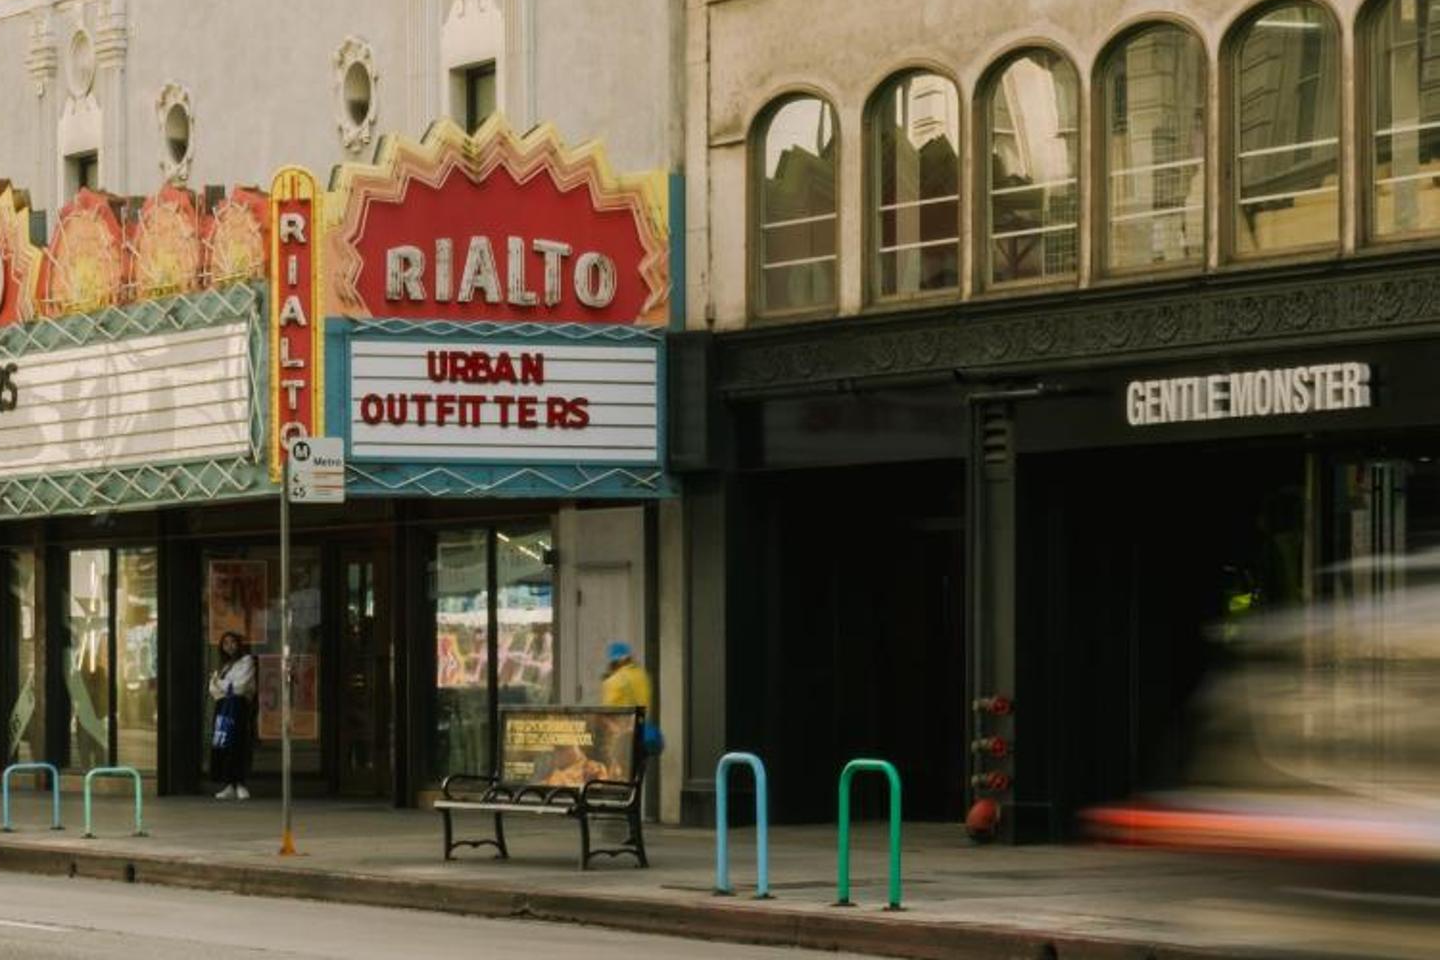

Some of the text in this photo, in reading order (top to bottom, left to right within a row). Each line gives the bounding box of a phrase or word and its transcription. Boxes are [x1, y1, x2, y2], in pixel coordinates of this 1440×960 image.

[386, 236, 617, 308] RIALTO
[279, 212, 308, 451] RIALTO
[426, 351, 544, 385] URBAN
[360, 394, 590, 428] OUTFITTERS
[1126, 362, 1371, 426] GENTLE MONSTER
[314, 457, 342, 467] Metro
